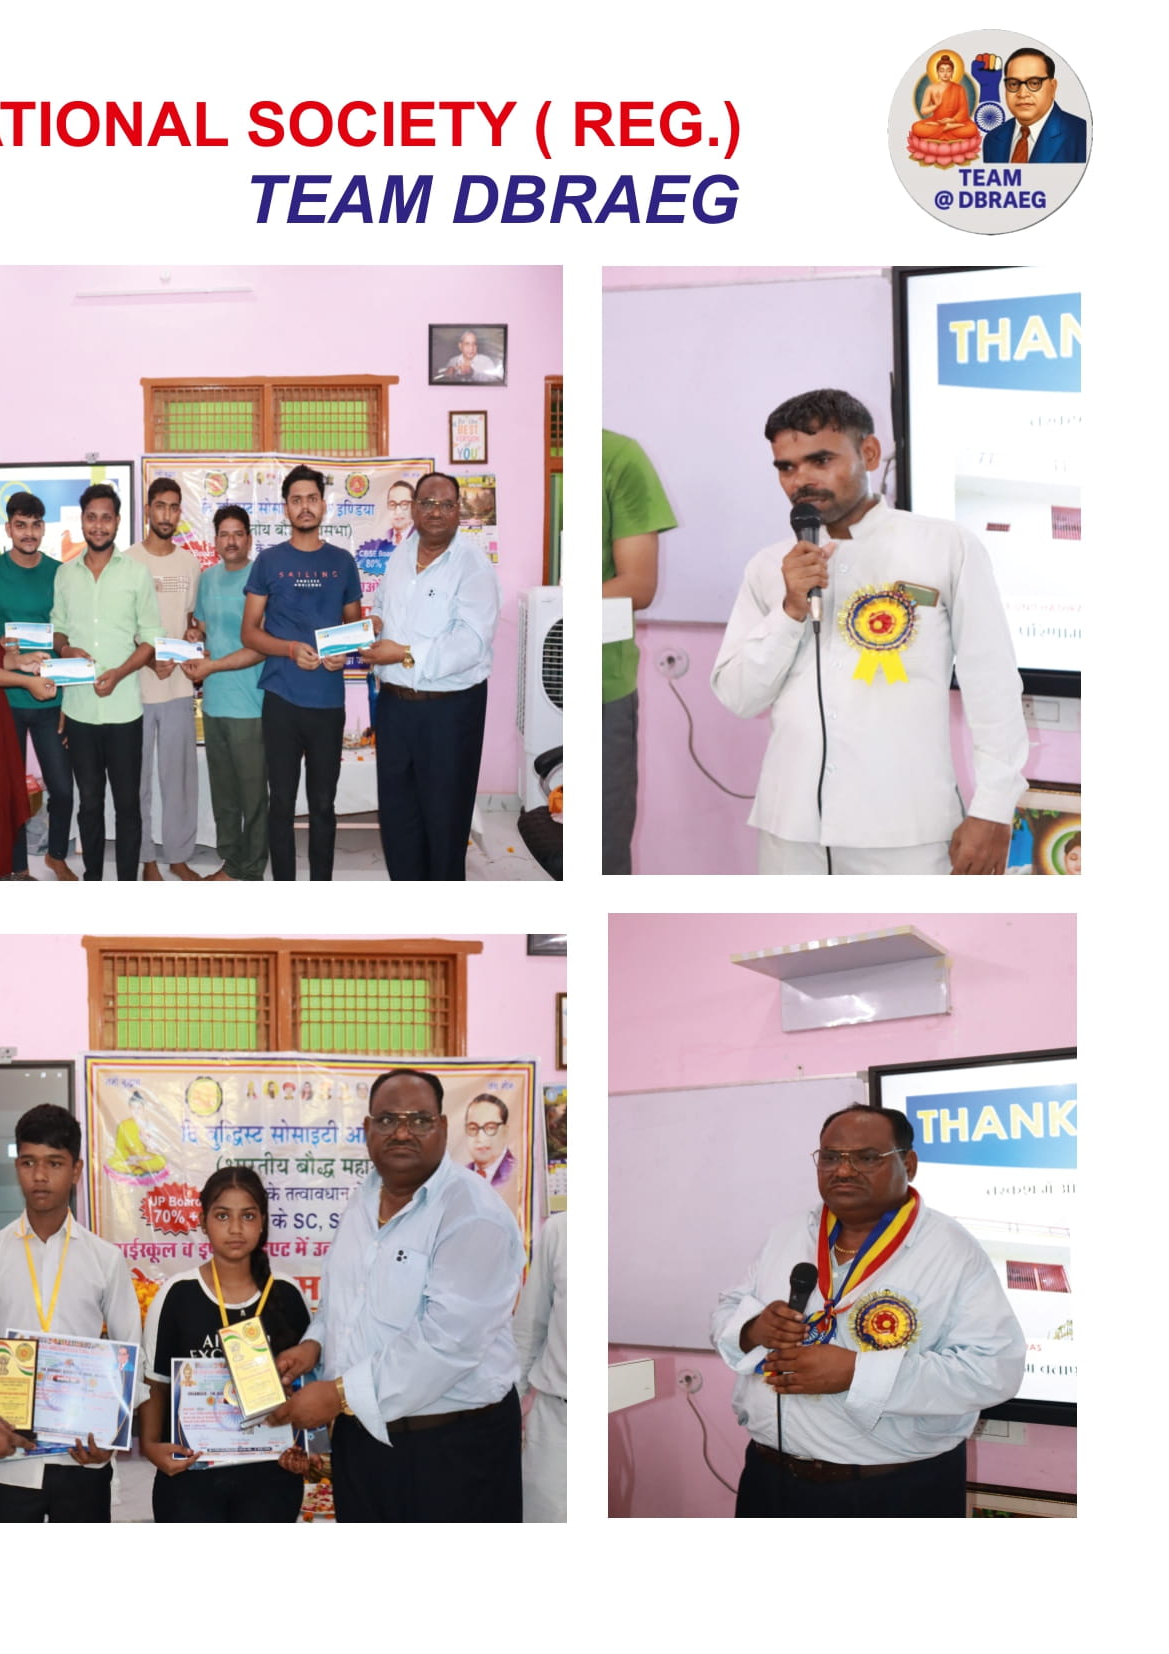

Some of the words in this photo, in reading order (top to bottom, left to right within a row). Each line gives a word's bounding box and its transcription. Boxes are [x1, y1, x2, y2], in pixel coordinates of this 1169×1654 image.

[949, 313, 1081, 364] THAN
[457, 447, 478, 460] YOU
[365, 559, 382, 568] 80%
[916, 1100, 1077, 1144] THANK
[270, 1119, 339, 1146] सोसाइटी
[296, 1151, 336, 1179] बौद्ध
[149, 1196, 166, 1207] UP
[154, 1209, 185, 1224] 70%
[270, 1208, 288, 1229] के
[293, 1212, 323, 1232] SC,
[329, 1212, 340, 1229] S
[182, 1243, 193, 1257] व
